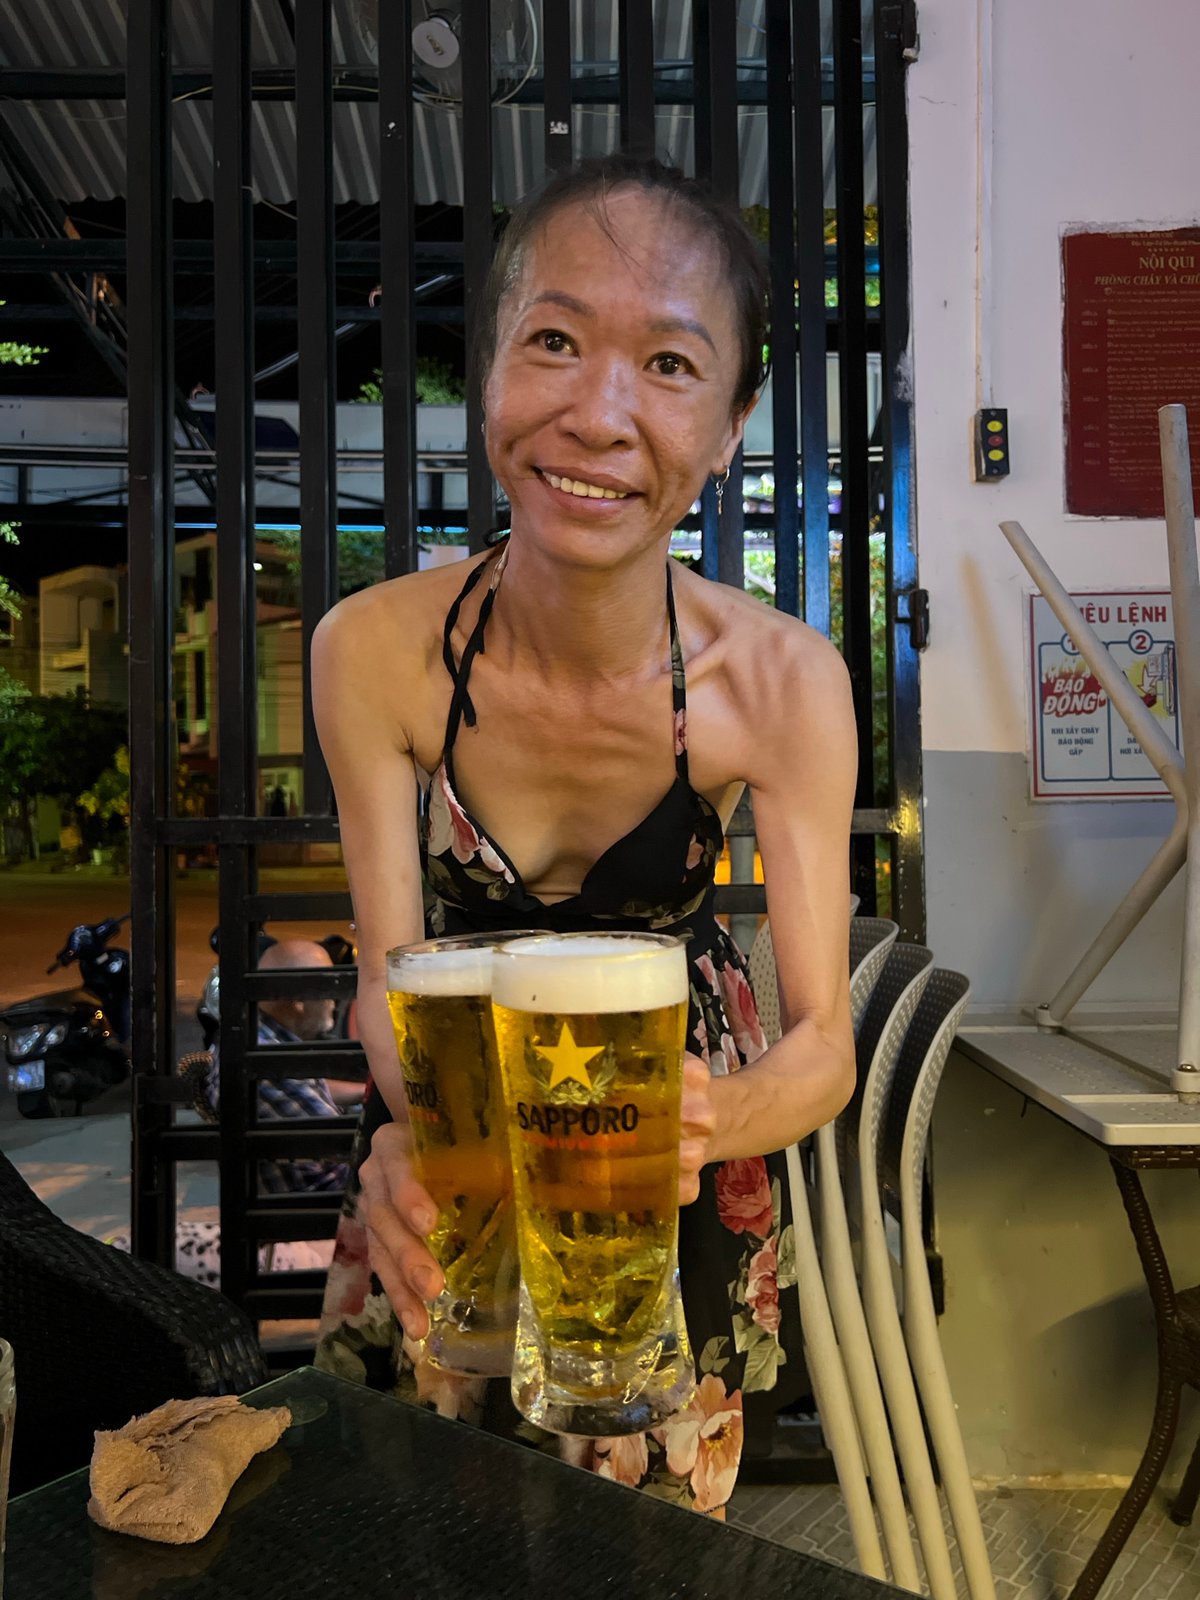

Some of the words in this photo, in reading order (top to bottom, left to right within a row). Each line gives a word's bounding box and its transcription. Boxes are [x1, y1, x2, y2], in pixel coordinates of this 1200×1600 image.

[1140, 253, 1164, 271] NỘI
[1168, 256, 1195, 271] QUI
[1095, 274, 1131, 285] PHÒNG
[1133, 274, 1162, 285] CHÁY
[1164, 273, 1178, 284] VÀ
[1117, 602, 1167, 626] LỆNH
[1135, 635, 1147, 650] 2
[1044, 692, 1098, 716] ĐỘNG
[517, 1102, 639, 1136] SAPPORO
